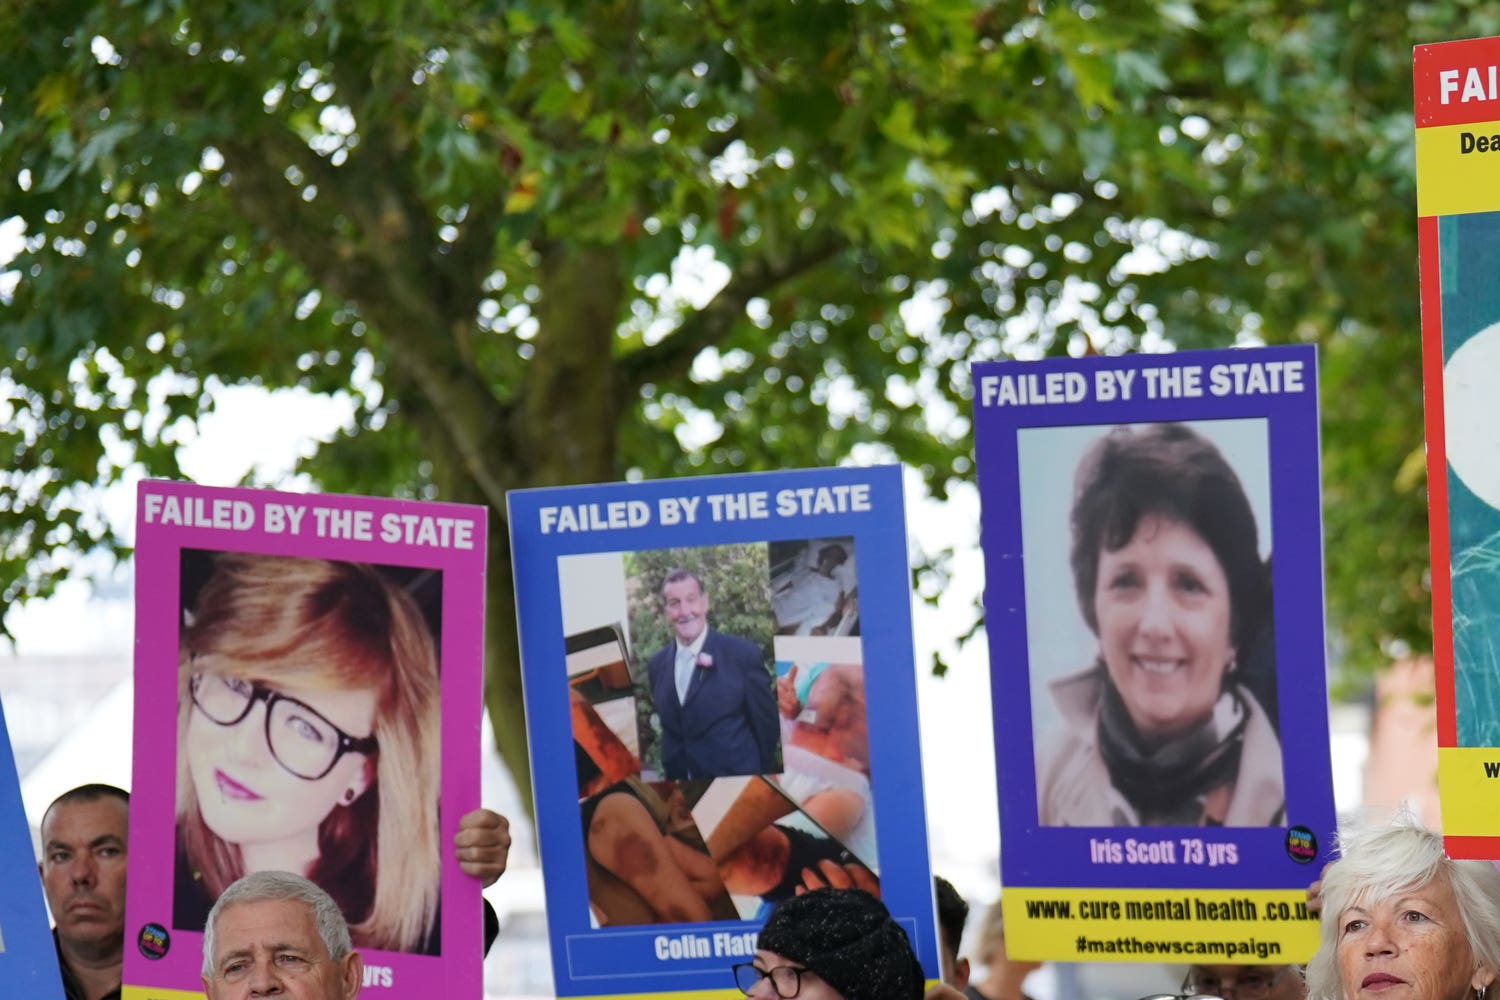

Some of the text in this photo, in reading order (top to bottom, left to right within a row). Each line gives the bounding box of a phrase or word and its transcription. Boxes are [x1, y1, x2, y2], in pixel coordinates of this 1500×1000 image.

[981, 361, 1304, 406] FAILED BY THE STATE
[144, 493, 474, 549] FAILED BY THE STATE
[539, 484, 871, 534] FAILED BY THE STATE
[1090, 838, 1239, 867] Iris Scott 73 yrs
[1026, 899, 1257, 922] www. cure mental health
[654, 935, 711, 960] Colin
[1076, 936, 1282, 959] #matthewscampaign
[363, 965, 393, 988] yrs
